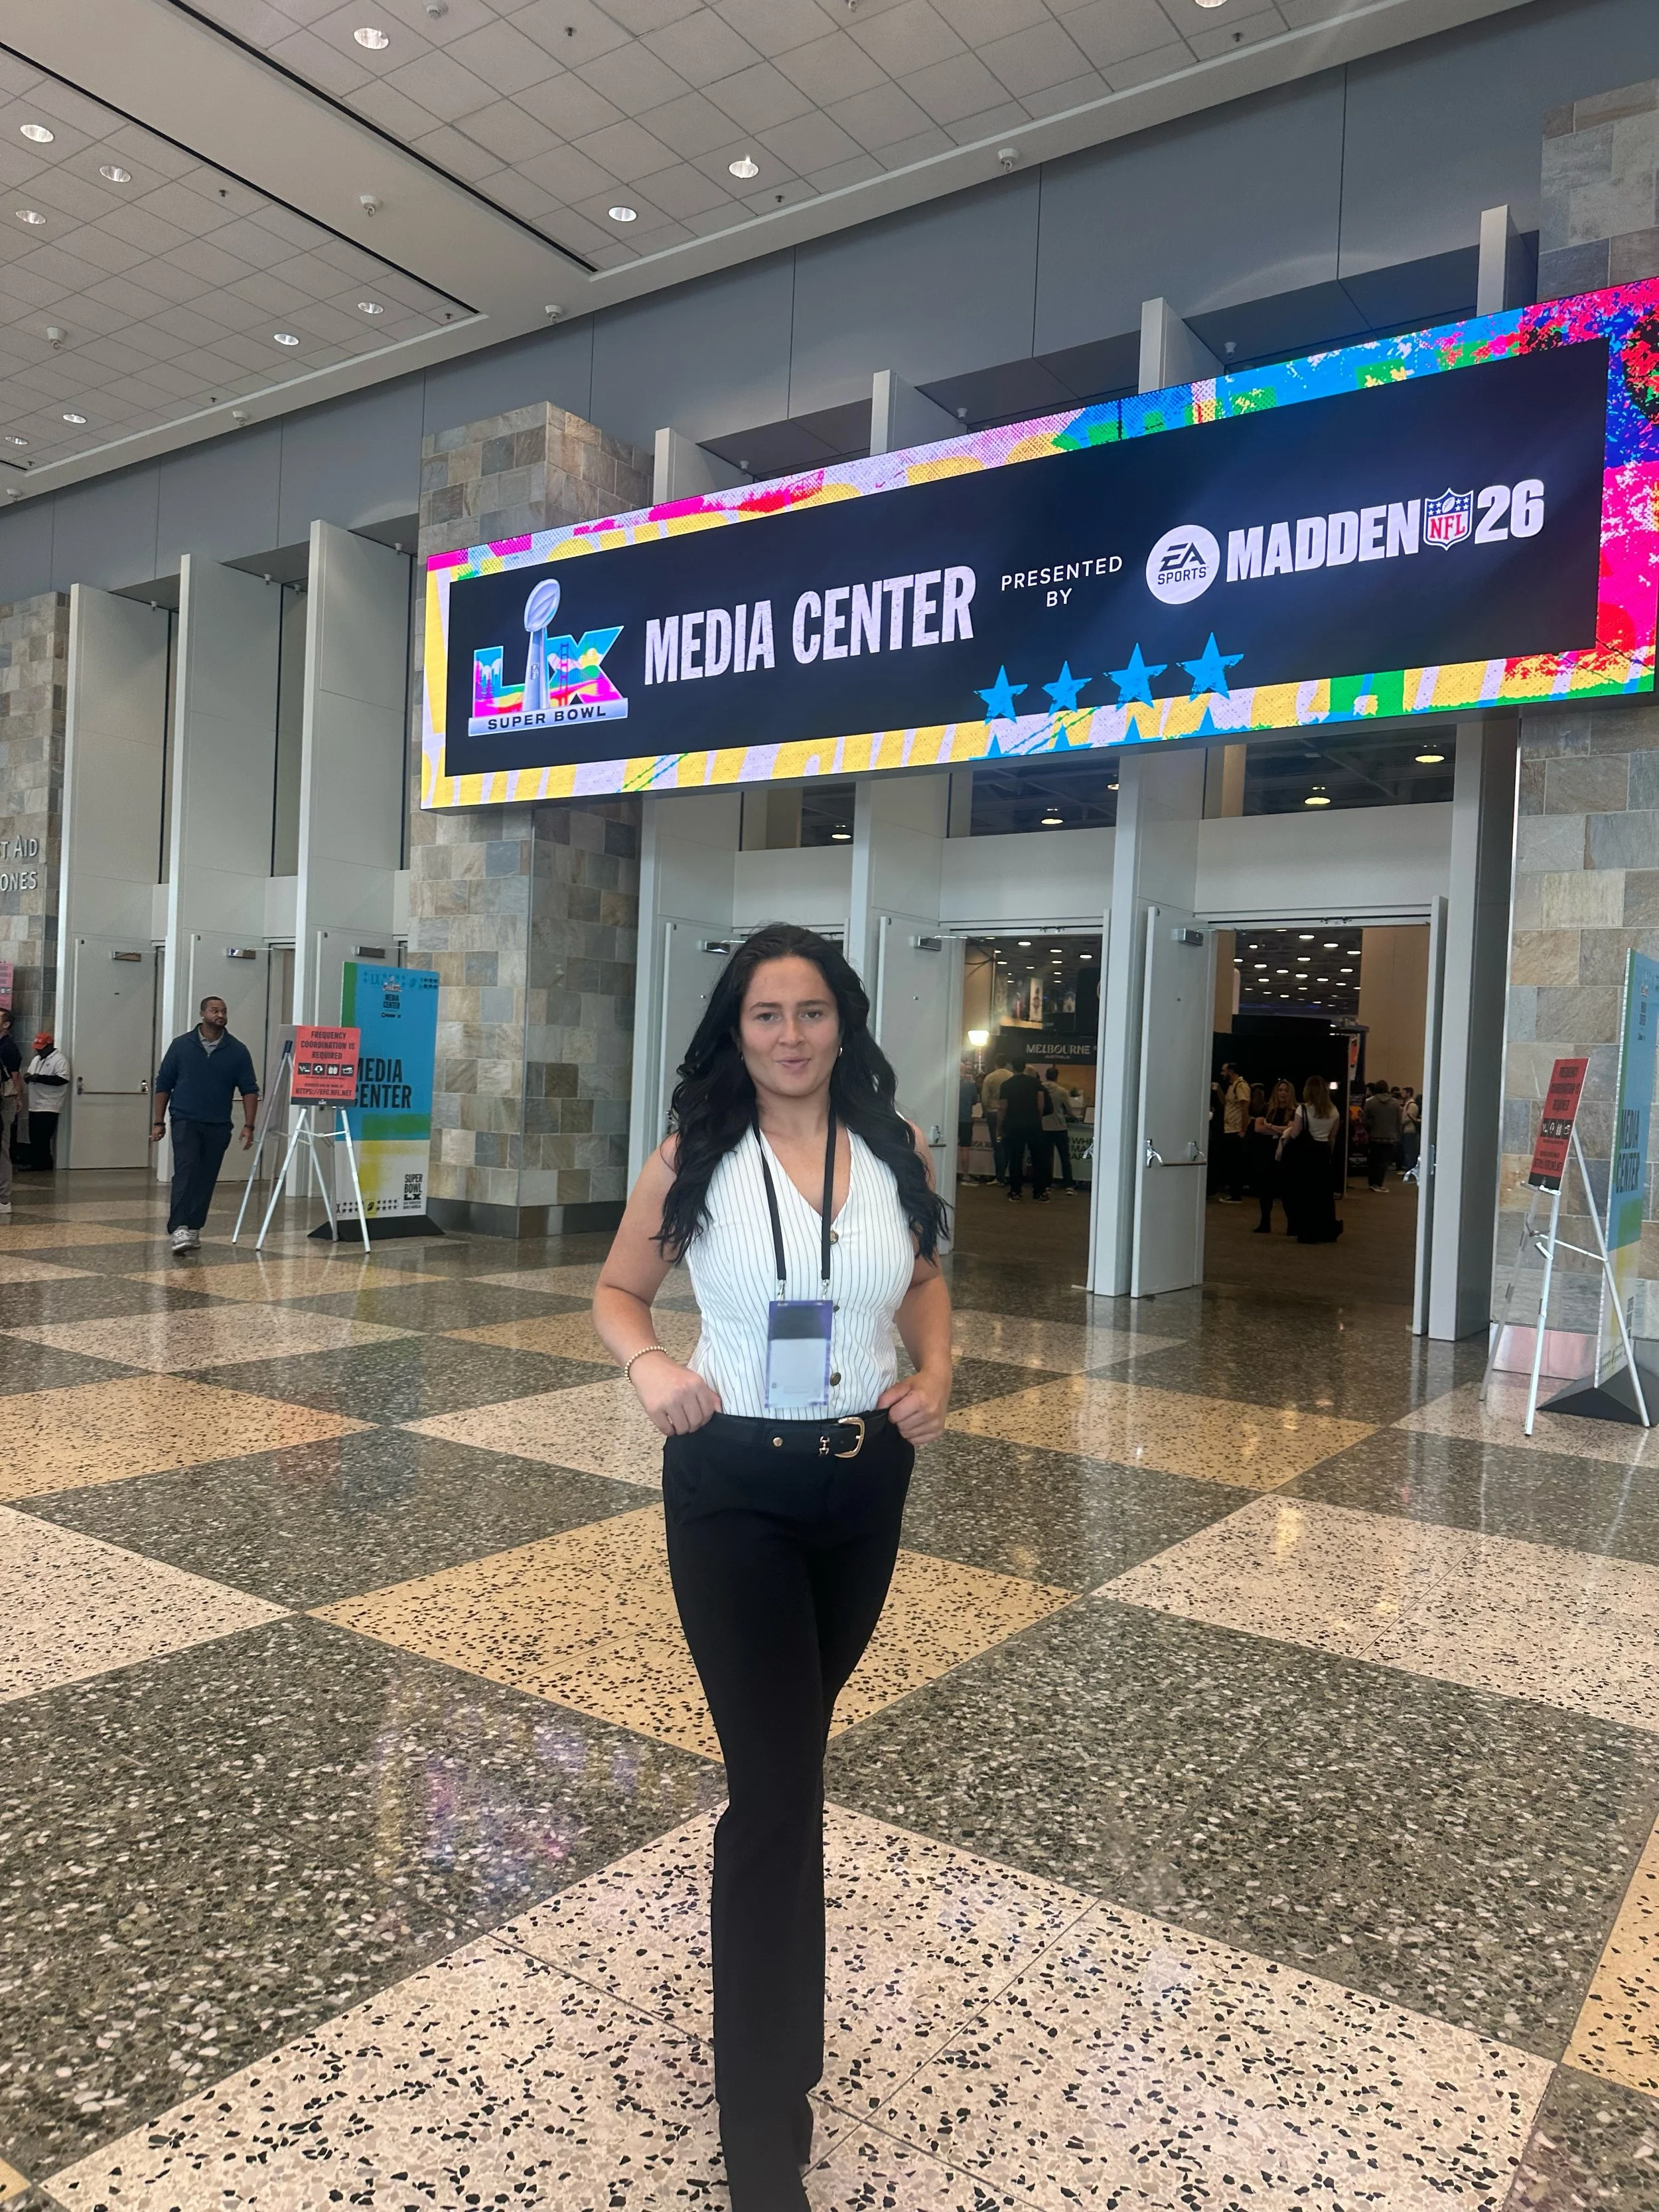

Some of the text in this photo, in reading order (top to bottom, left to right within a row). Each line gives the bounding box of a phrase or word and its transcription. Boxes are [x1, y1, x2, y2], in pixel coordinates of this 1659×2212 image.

[1226, 479, 1544, 582] MADDEN NFL 26
[1159, 542, 1206, 572] EA
[1001, 555, 1122, 591] PRESENTED
[1157, 567, 1207, 585] SPORTS
[1046, 588, 1072, 607] BY
[644, 565, 976, 685] MEDIA CENTER
[488, 705, 606, 730] SUPER BOWL
[14, 834, 38, 858] AID
[311, 1031, 346, 1039] FREQUENCY
[301, 1041, 346, 1049] COORDINATION
[1026, 1044, 1090, 1054] MELBOURNE
[405, 1173, 423, 1183] SUPER
[404, 1183, 422, 1193] BOWL
